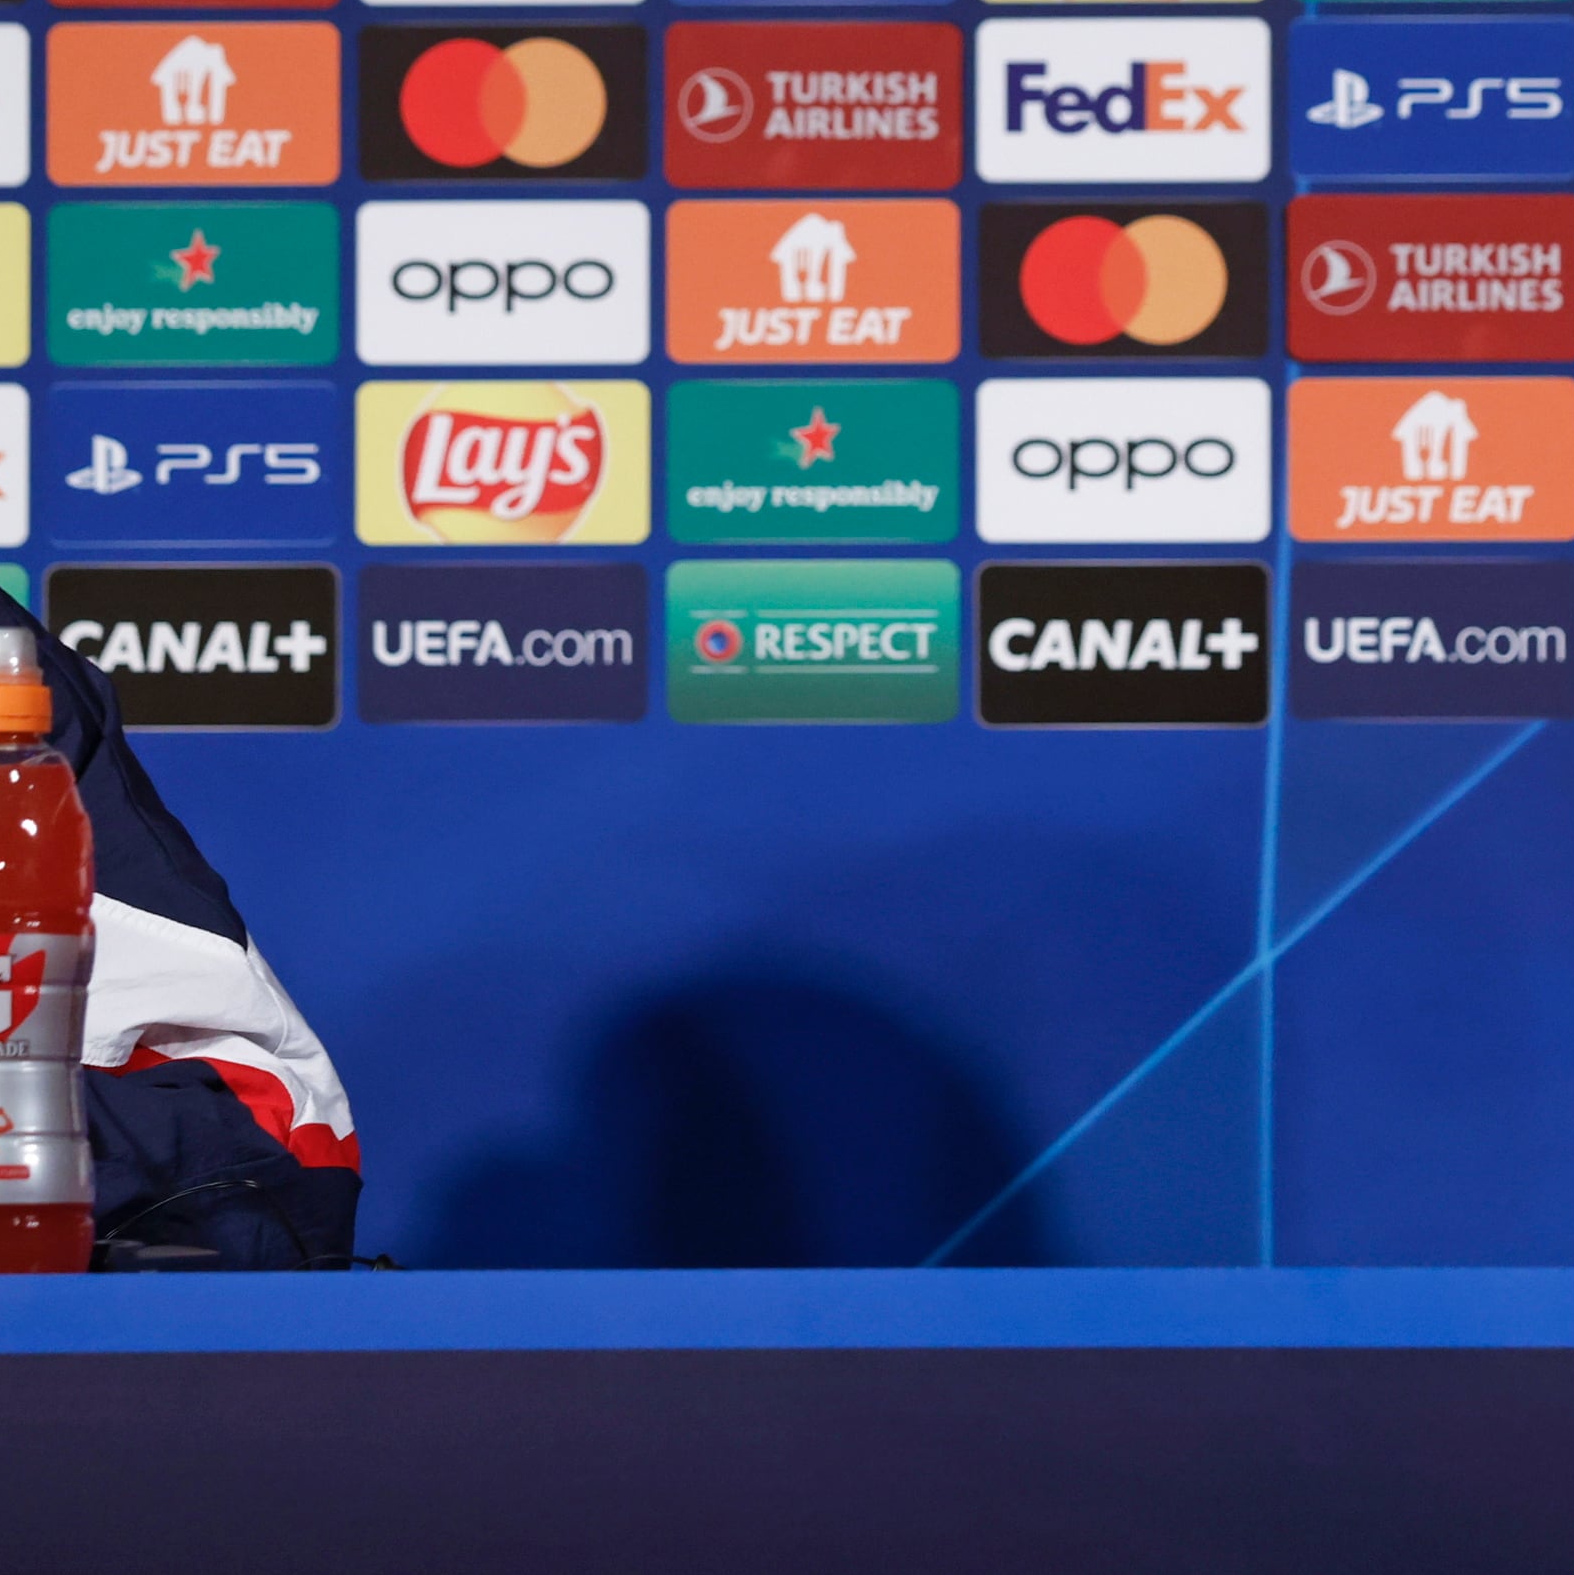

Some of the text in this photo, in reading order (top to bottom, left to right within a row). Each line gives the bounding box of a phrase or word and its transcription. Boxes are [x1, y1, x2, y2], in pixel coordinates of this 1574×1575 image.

[767, 71, 937, 108] TURKISH
[1006, 62, 1245, 133] FedEx
[1398, 78, 1562, 119] PS5
[765, 107, 939, 139] AIRLINES
[96, 130, 291, 173] JUST EAT
[1390, 243, 1561, 276] TURKISH
[391, 260, 615, 313] oppo
[1388, 278, 1563, 311] AIRLINES
[67, 302, 319, 335] enjoy responsibly
[715, 307, 911, 350] JUST EAT
[156, 444, 320, 484] PS5
[412, 413, 595, 519] Lay's
[1012, 438, 1235, 491] oppo
[686, 480, 939, 512] enjoy responsibly
[1337, 486, 1534, 528] JUST EAT
[58, 619, 326, 674] CANAL+
[373, 621, 632, 666] UEFA.com
[755, 623, 937, 660] RESPECT
[989, 618, 1258, 671] CANAL+
[1305, 617, 1565, 663] UEFA.com
